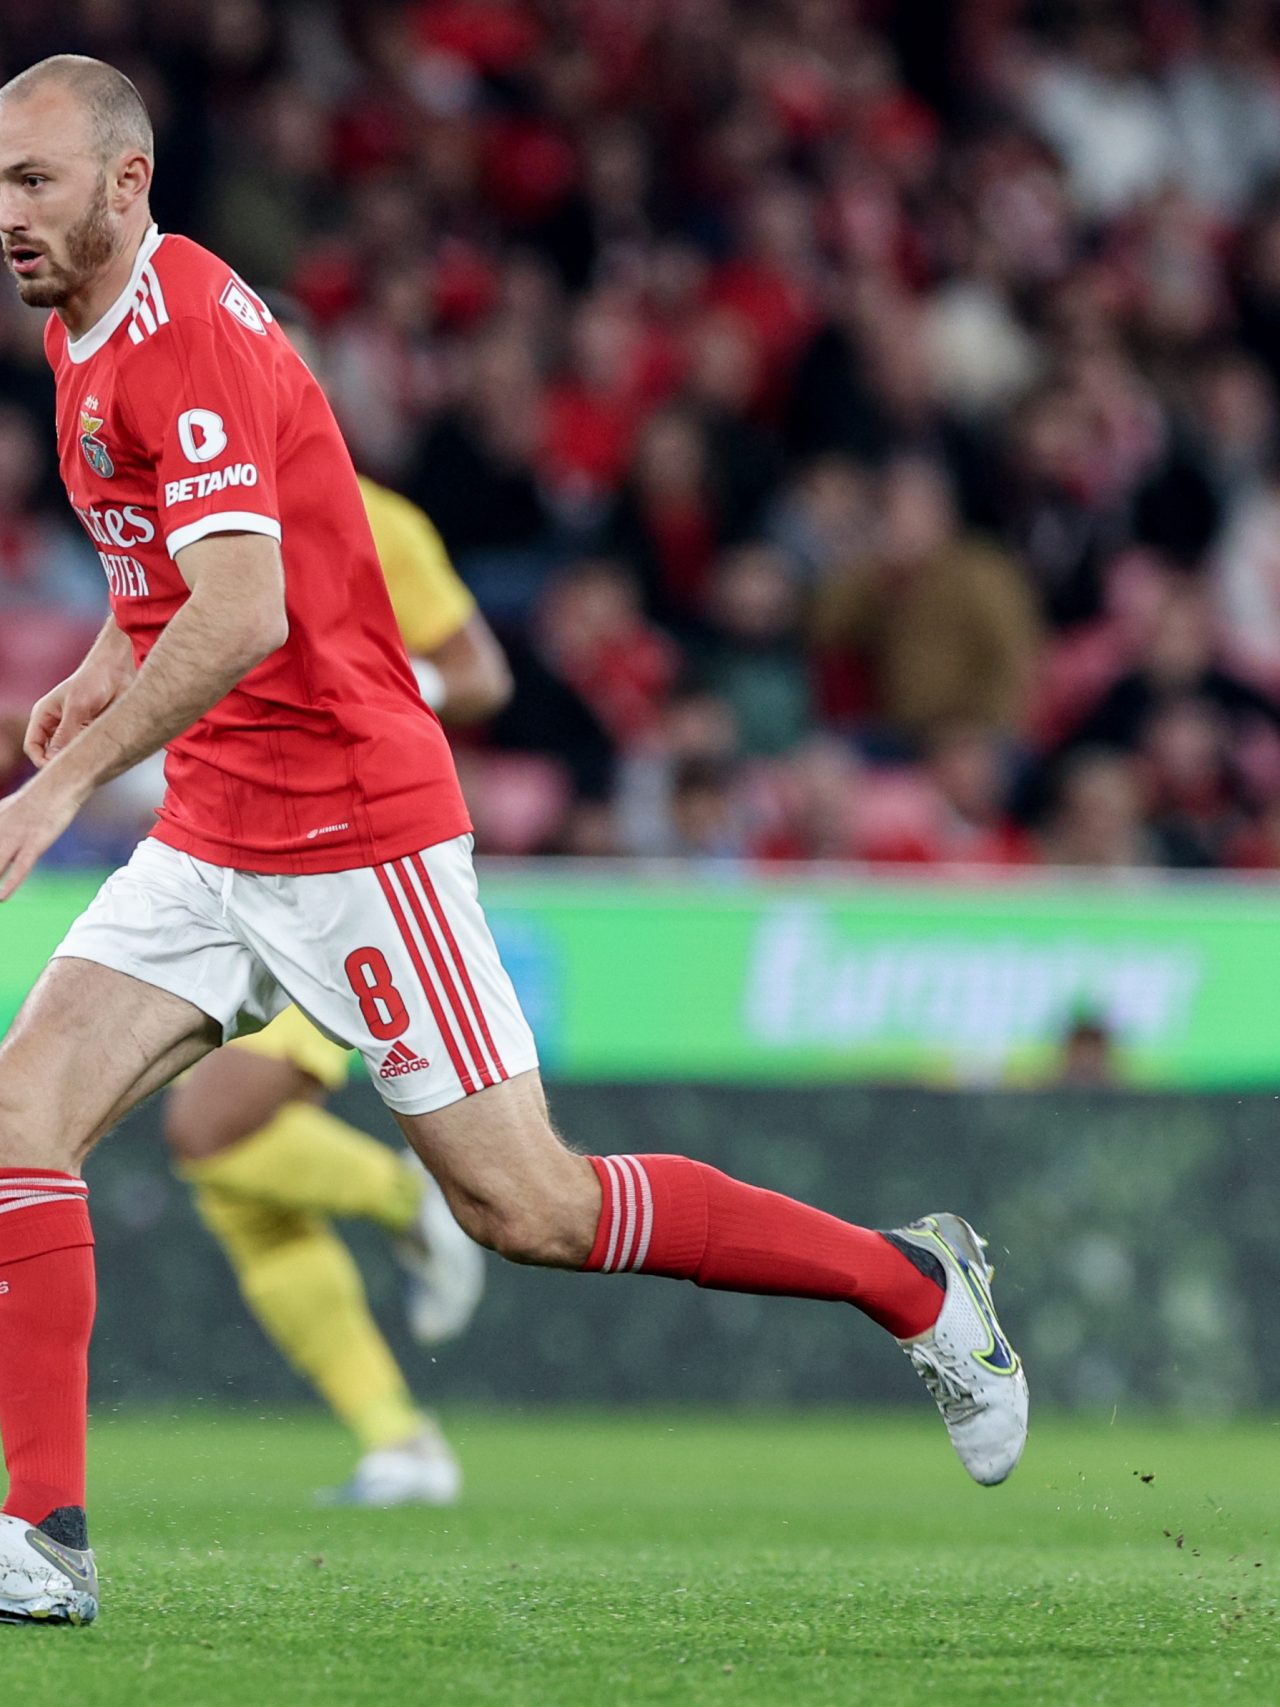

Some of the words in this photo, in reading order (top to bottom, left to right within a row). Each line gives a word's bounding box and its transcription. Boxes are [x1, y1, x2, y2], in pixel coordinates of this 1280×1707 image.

[165, 464, 258, 508] BETANO
[344, 946, 410, 1040] 8
[380, 1057, 430, 1079] adidas
